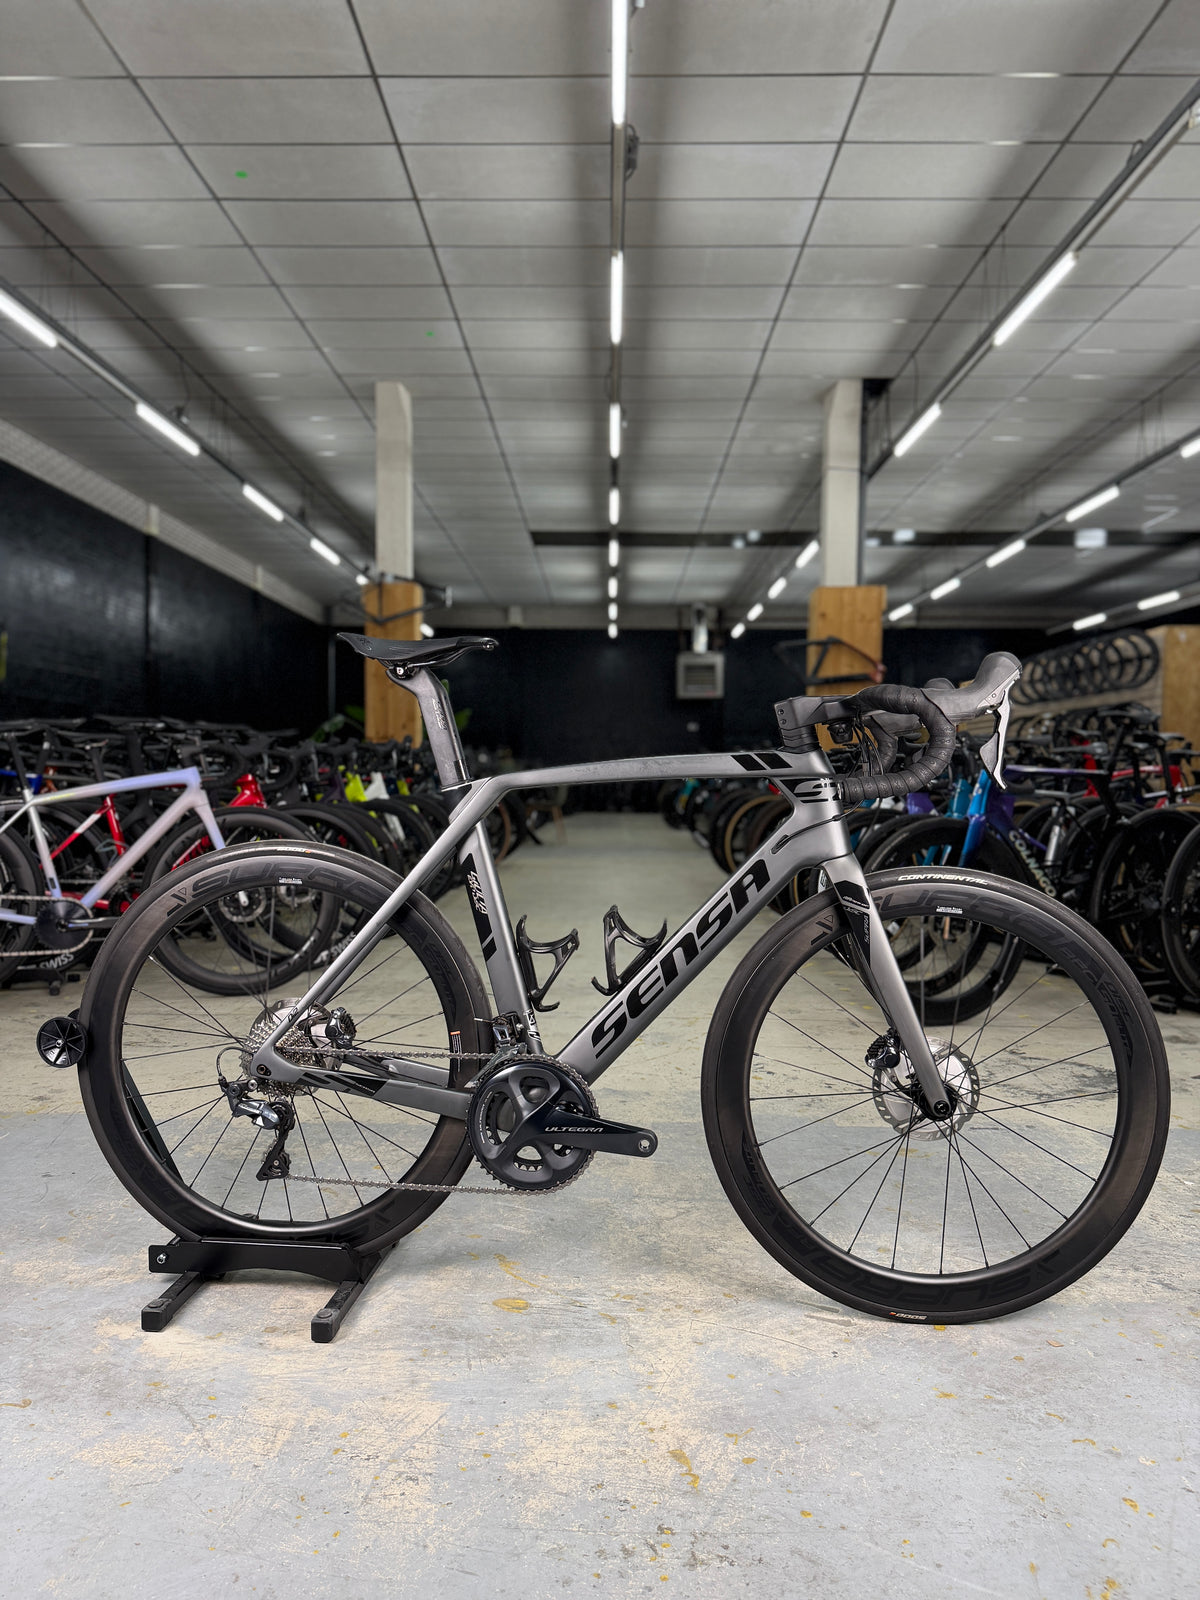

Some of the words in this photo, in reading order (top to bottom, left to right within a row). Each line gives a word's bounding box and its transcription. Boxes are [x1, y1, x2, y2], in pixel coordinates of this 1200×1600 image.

[898, 873, 989, 885] CONTINENTAL
[1008, 829, 1057, 897] COLNAGO
[591, 859, 770, 1059] SENSA
